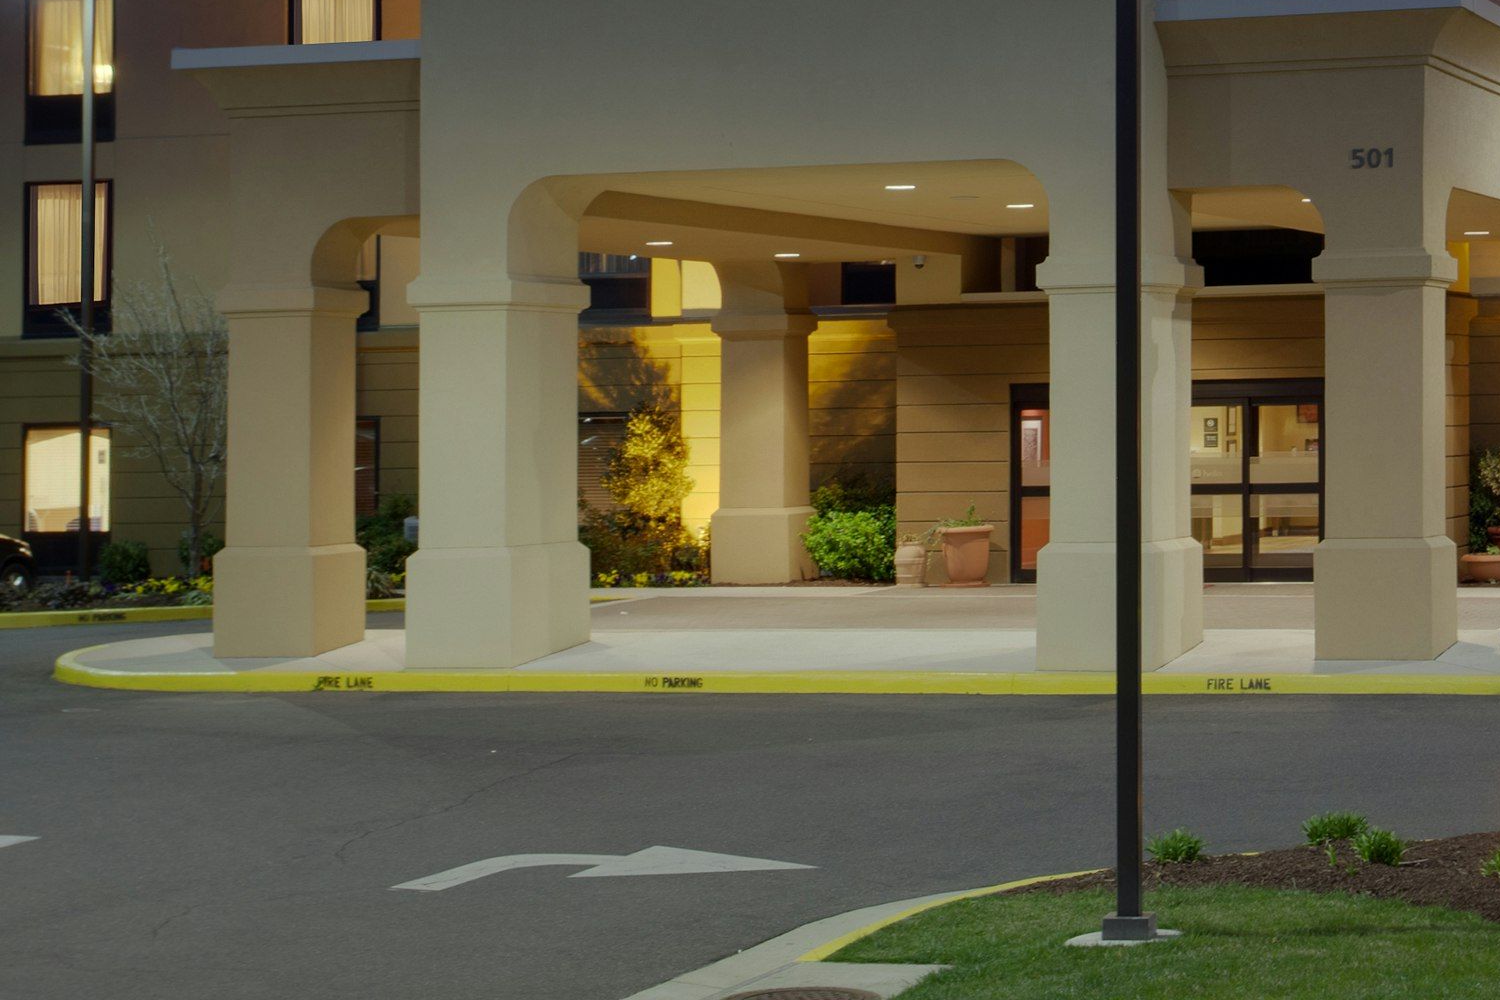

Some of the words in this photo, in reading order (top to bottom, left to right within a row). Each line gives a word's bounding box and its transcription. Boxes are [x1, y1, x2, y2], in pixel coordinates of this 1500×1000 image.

[1351, 147, 1394, 169] 501
[644, 677, 659, 688] NO
[662, 676, 704, 688] PARKING
[1206, 678, 1234, 690] FIRE
[1240, 678, 1271, 690] LANE
